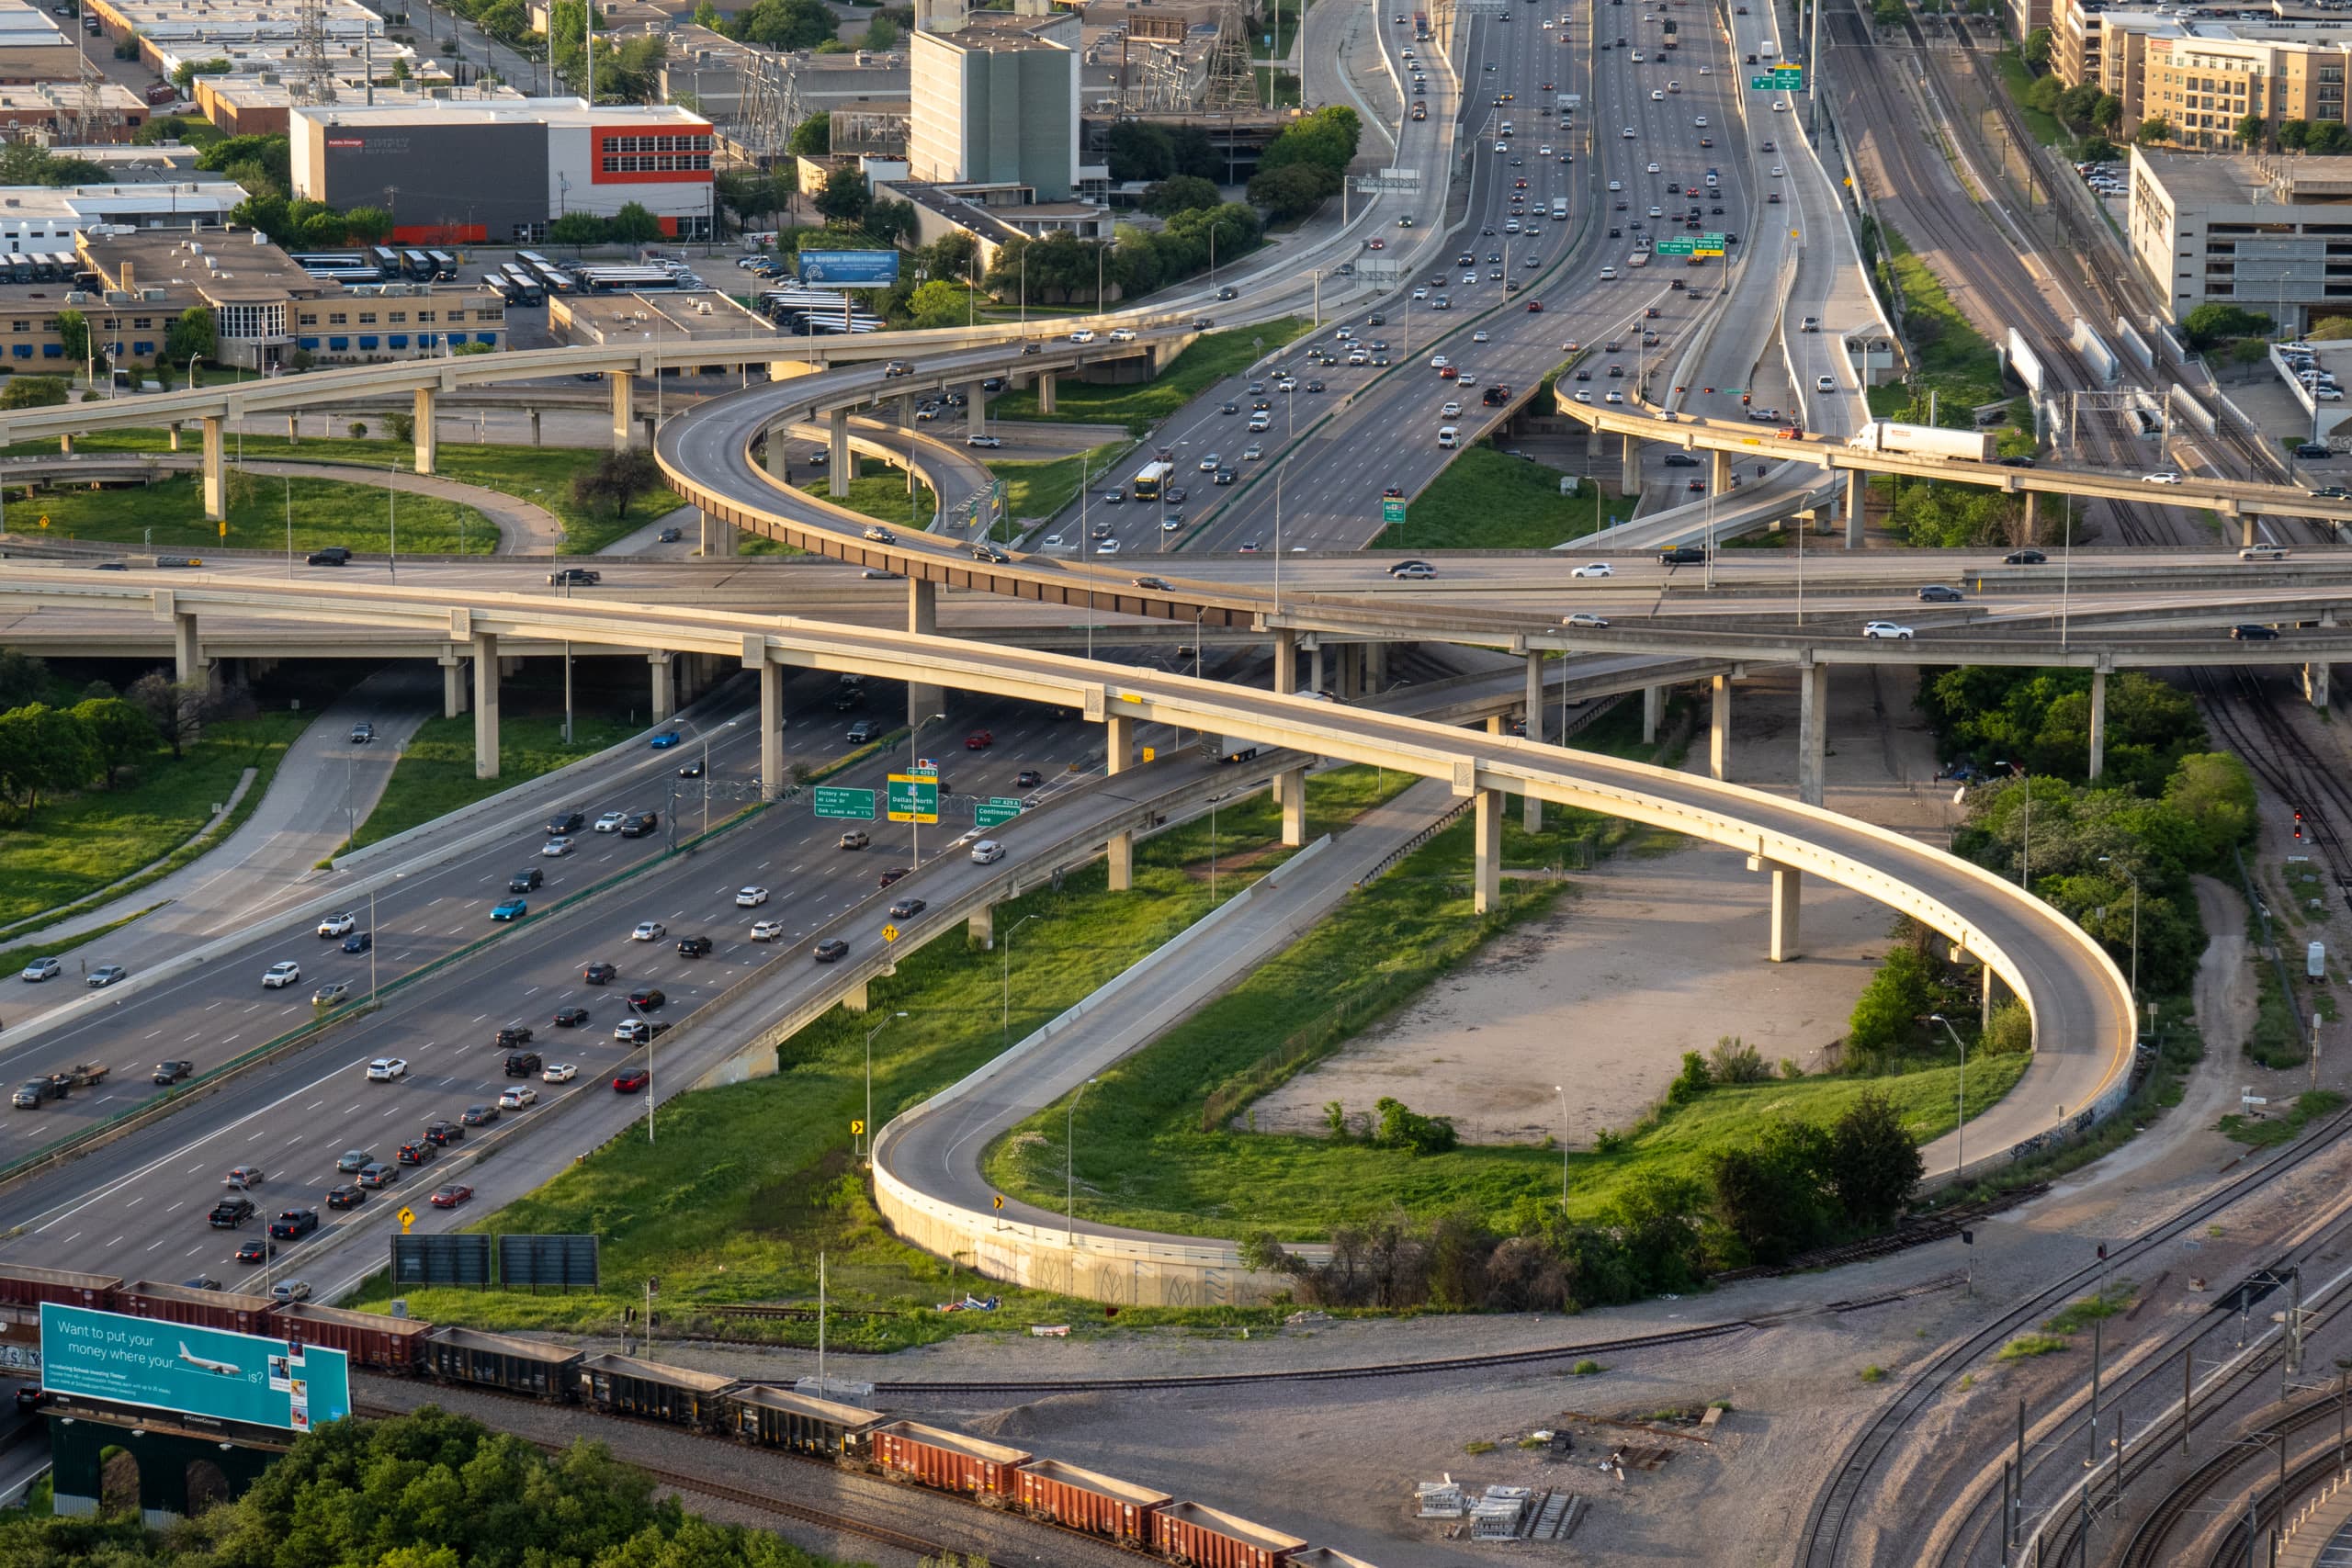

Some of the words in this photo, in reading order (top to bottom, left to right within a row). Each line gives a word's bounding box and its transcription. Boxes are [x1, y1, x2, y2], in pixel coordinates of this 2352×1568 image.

[978, 808, 1017, 817] Continental
[57, 1320, 89, 1337] Want
[91, 1326, 104, 1339] to
[107, 1331, 126, 1343] put
[129, 1335, 154, 1348] your
[68, 1343, 107, 1360] money
[109, 1348, 146, 1364] where
[148, 1355, 175, 1369] your
[247, 1370, 264, 1384] is?
